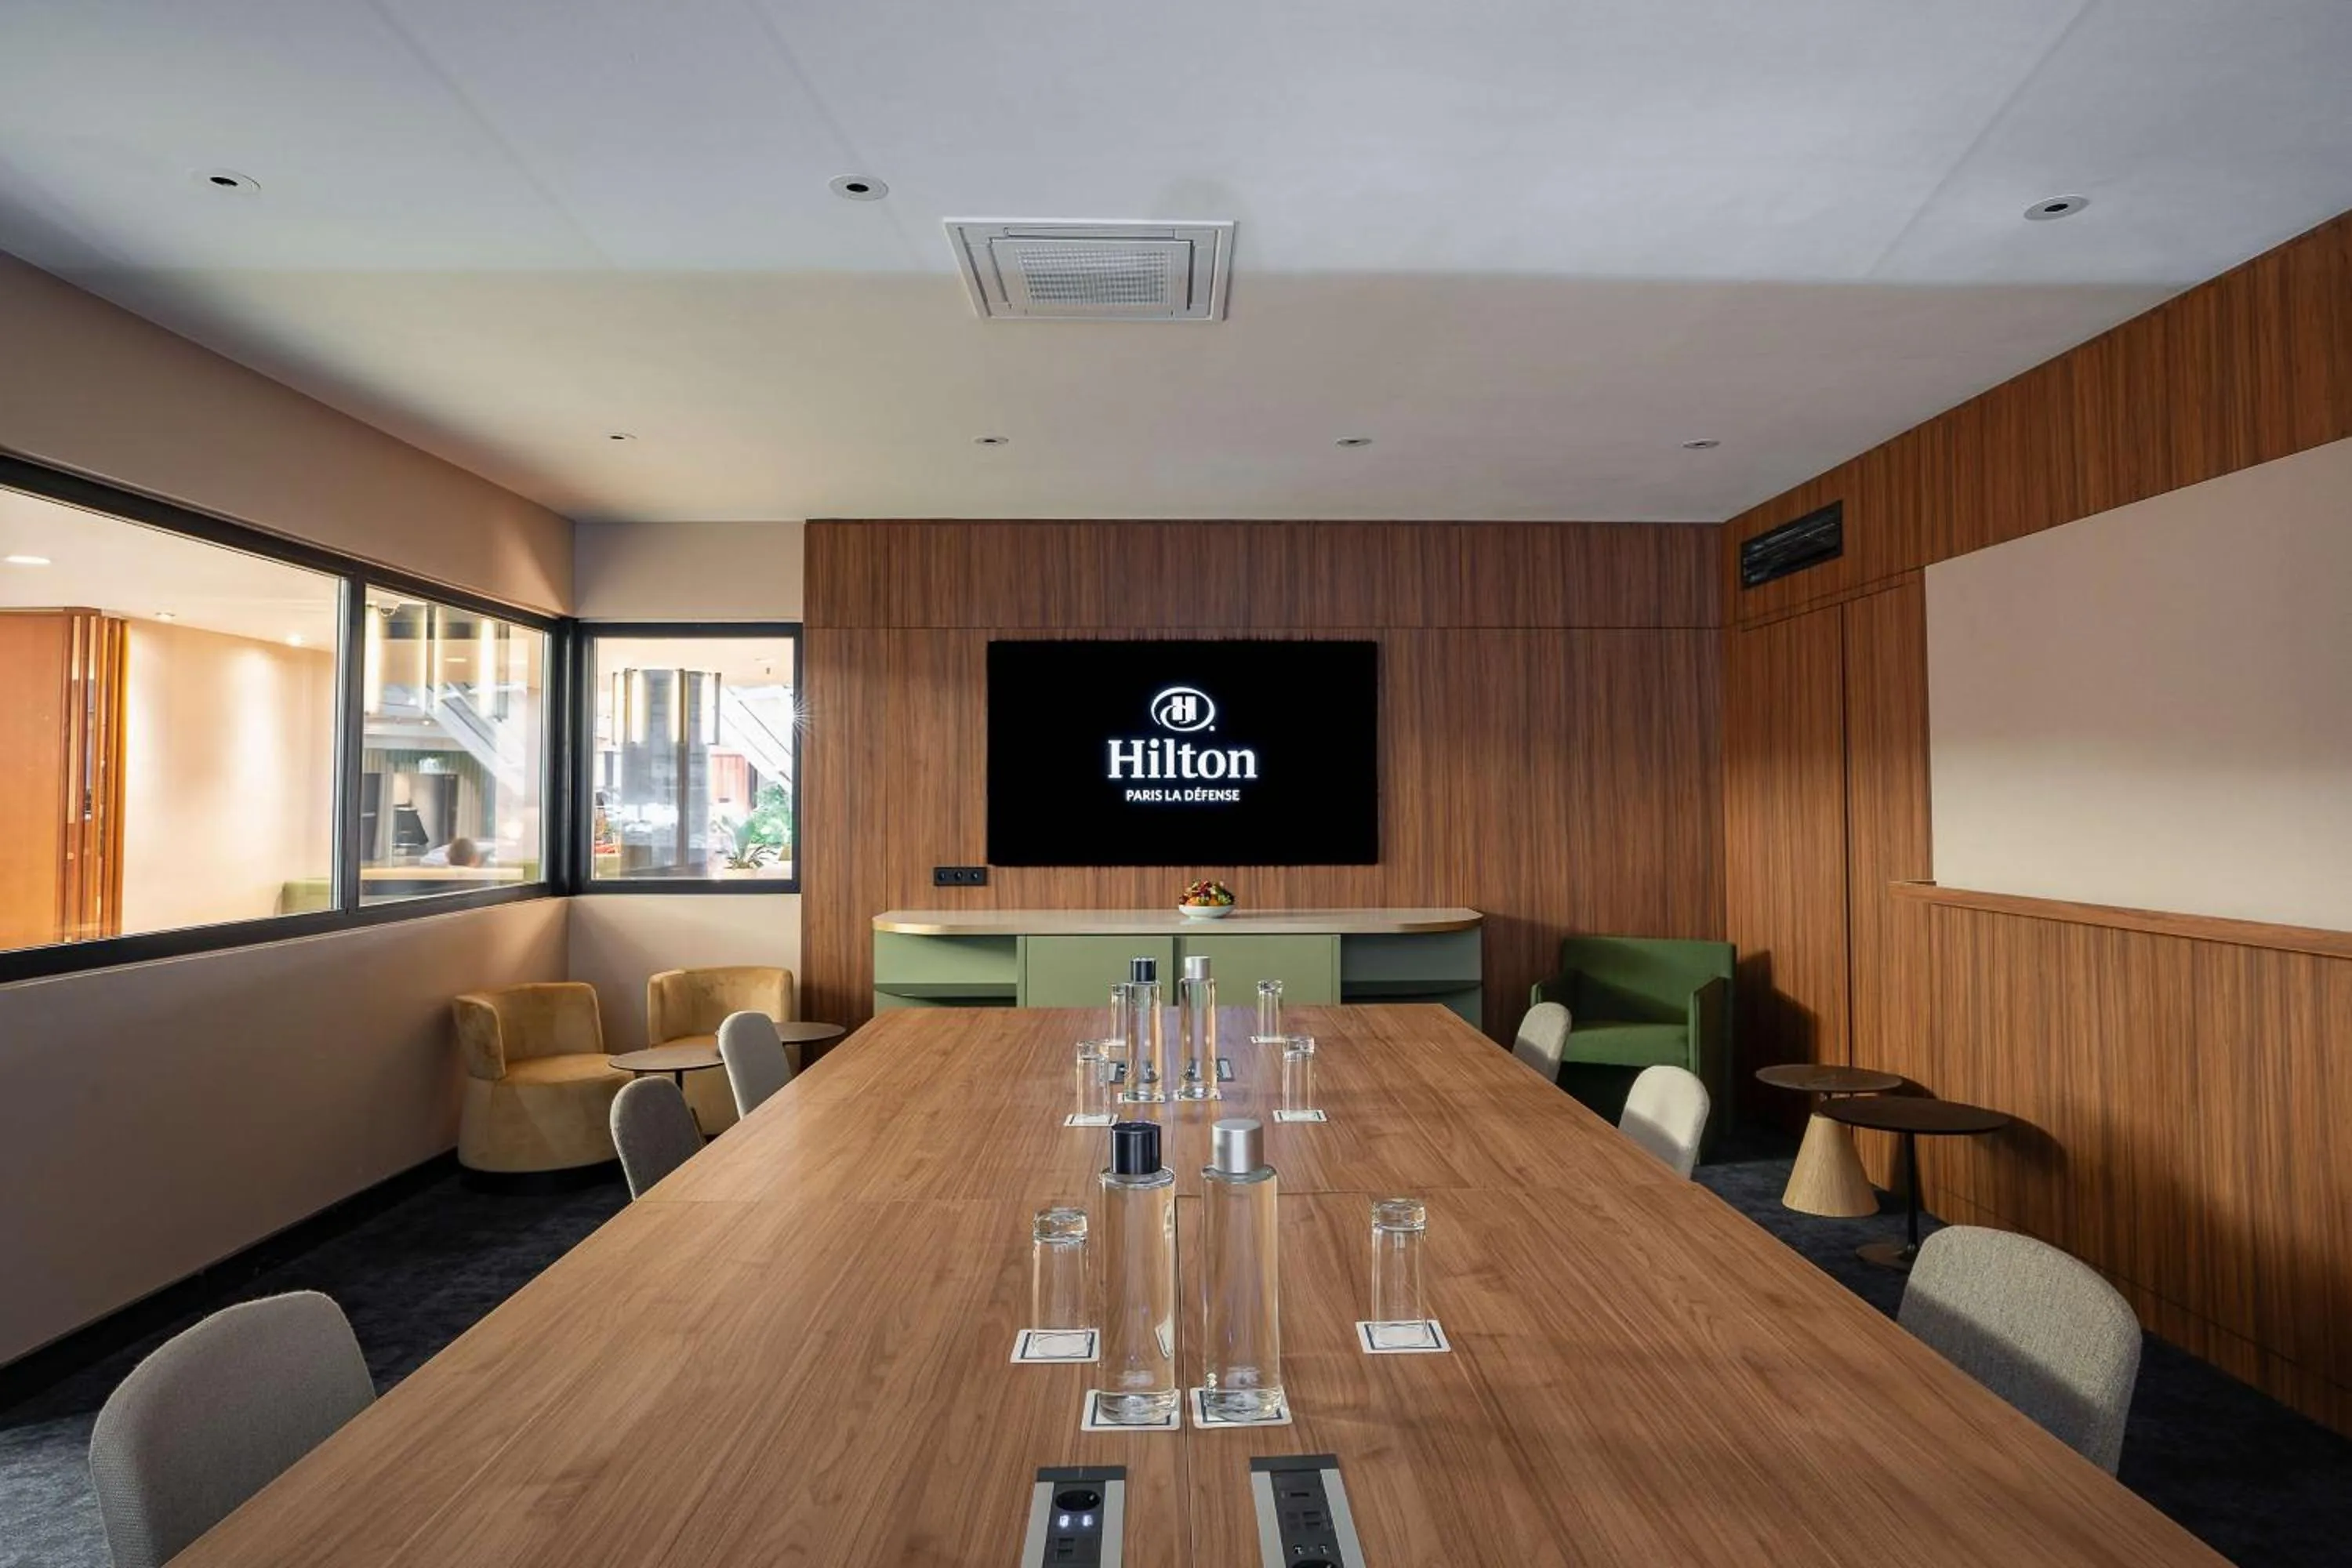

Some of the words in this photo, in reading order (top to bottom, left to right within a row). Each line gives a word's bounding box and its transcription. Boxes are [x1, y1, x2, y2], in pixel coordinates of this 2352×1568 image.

[1107, 738, 1258, 779] Hilton
[1125, 789, 1163, 802] PARIS
[1165, 789, 1182, 802] LA
[1185, 786, 1240, 802] DÉFENSE
